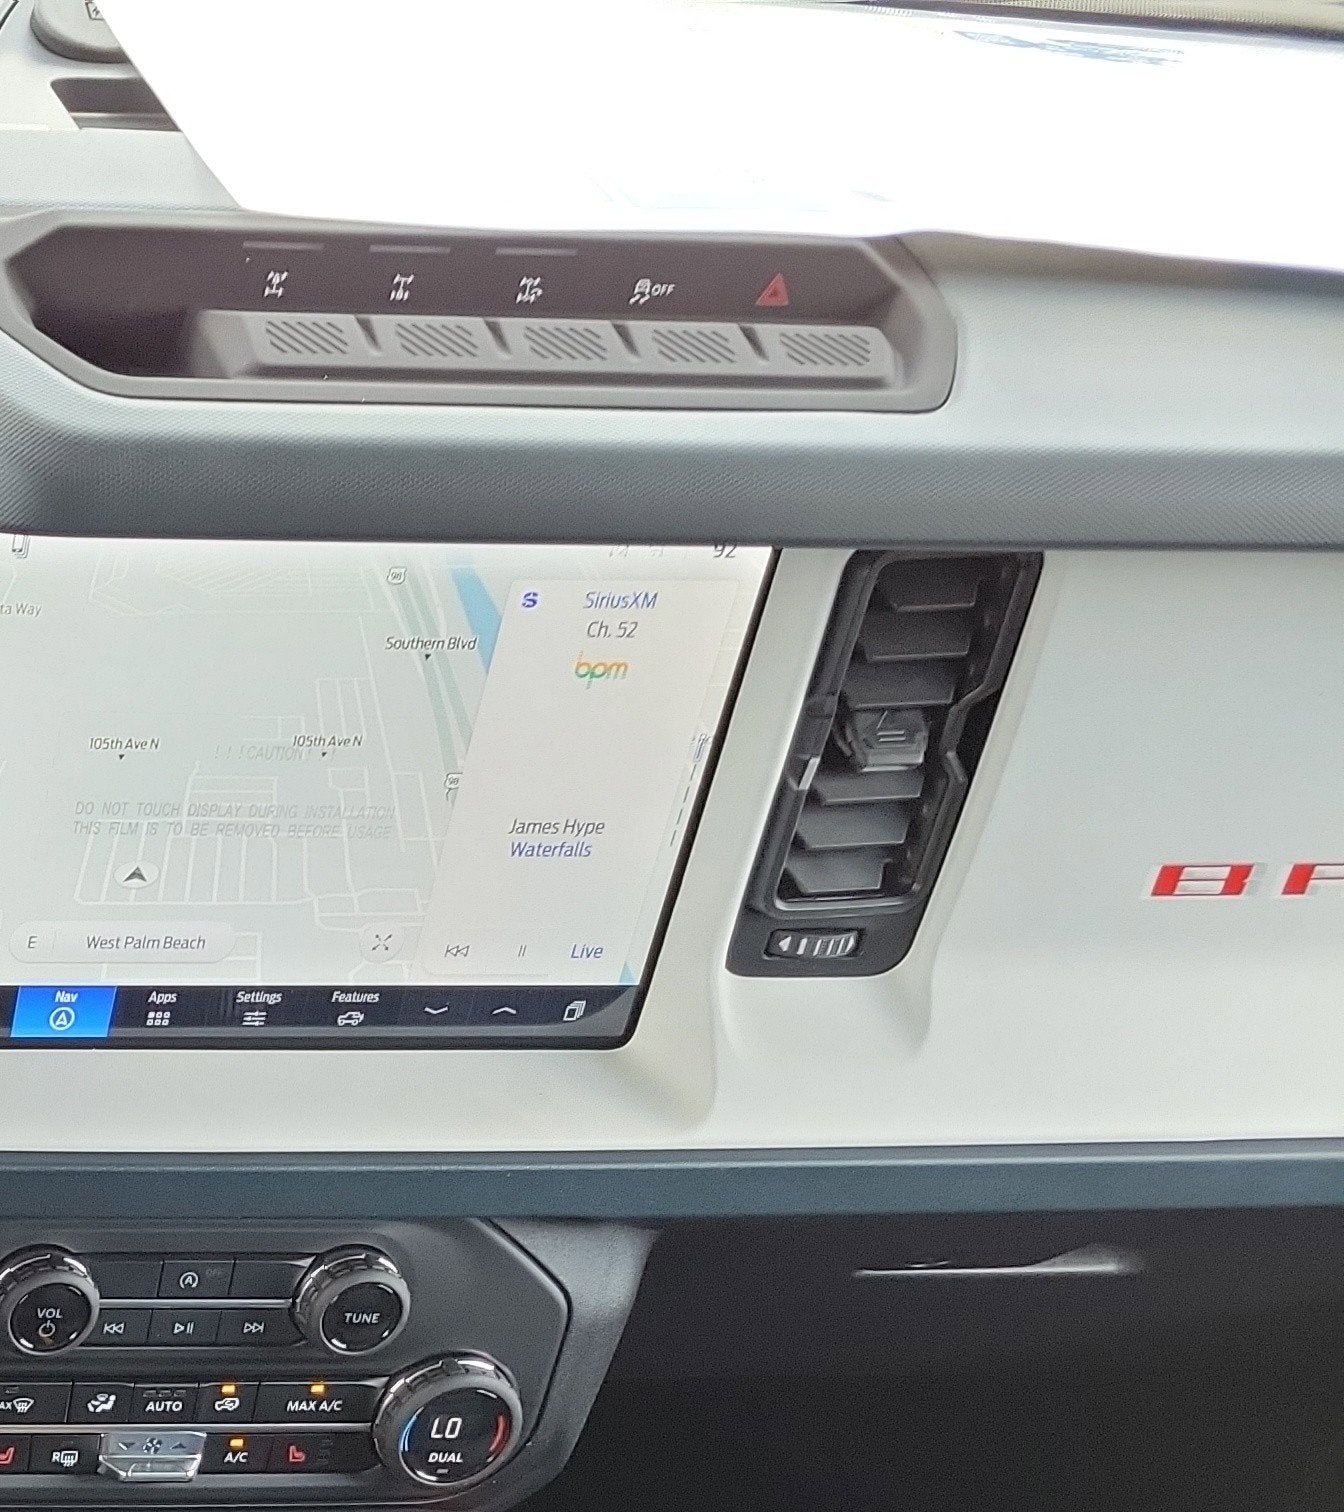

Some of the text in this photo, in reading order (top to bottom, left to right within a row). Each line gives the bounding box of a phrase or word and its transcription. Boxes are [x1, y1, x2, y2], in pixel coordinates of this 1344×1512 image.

[651, 283, 675, 297] OFF
[583, 591, 659, 609] SiriusXM
[15, 602, 42, 617] Way
[587, 621, 639, 638] Ch. 52
[385, 636, 478, 650] Southern Blvd
[574, 651, 630, 689] bpm
[88, 737, 160, 750] 105th Ave N
[291, 734, 363, 748] 105th Ave N
[102, 802, 129, 816] NOT
[136, 802, 179, 817] TOUCH
[508, 818, 605, 838] James Hype
[510, 840, 592, 858] Waterfalls
[27, 936, 37, 949] E
[86, 935, 206, 950] West Palm Beach
[570, 944, 603, 959] Live
[54, 990, 79, 1003] Nav
[148, 991, 177, 1005] Apps
[236, 990, 282, 1005] Settings
[331, 990, 380, 1003] Features
[36, 1308, 63, 1319] VOL
[344, 1312, 380, 1324] TUNE
[145, 1401, 183, 1412] AUTO
[286, 1400, 343, 1412] MAX A/C
[430, 1417, 462, 1439] LO
[223, 1452, 248, 1464] A/C
[428, 1452, 464, 1463] DUAL
